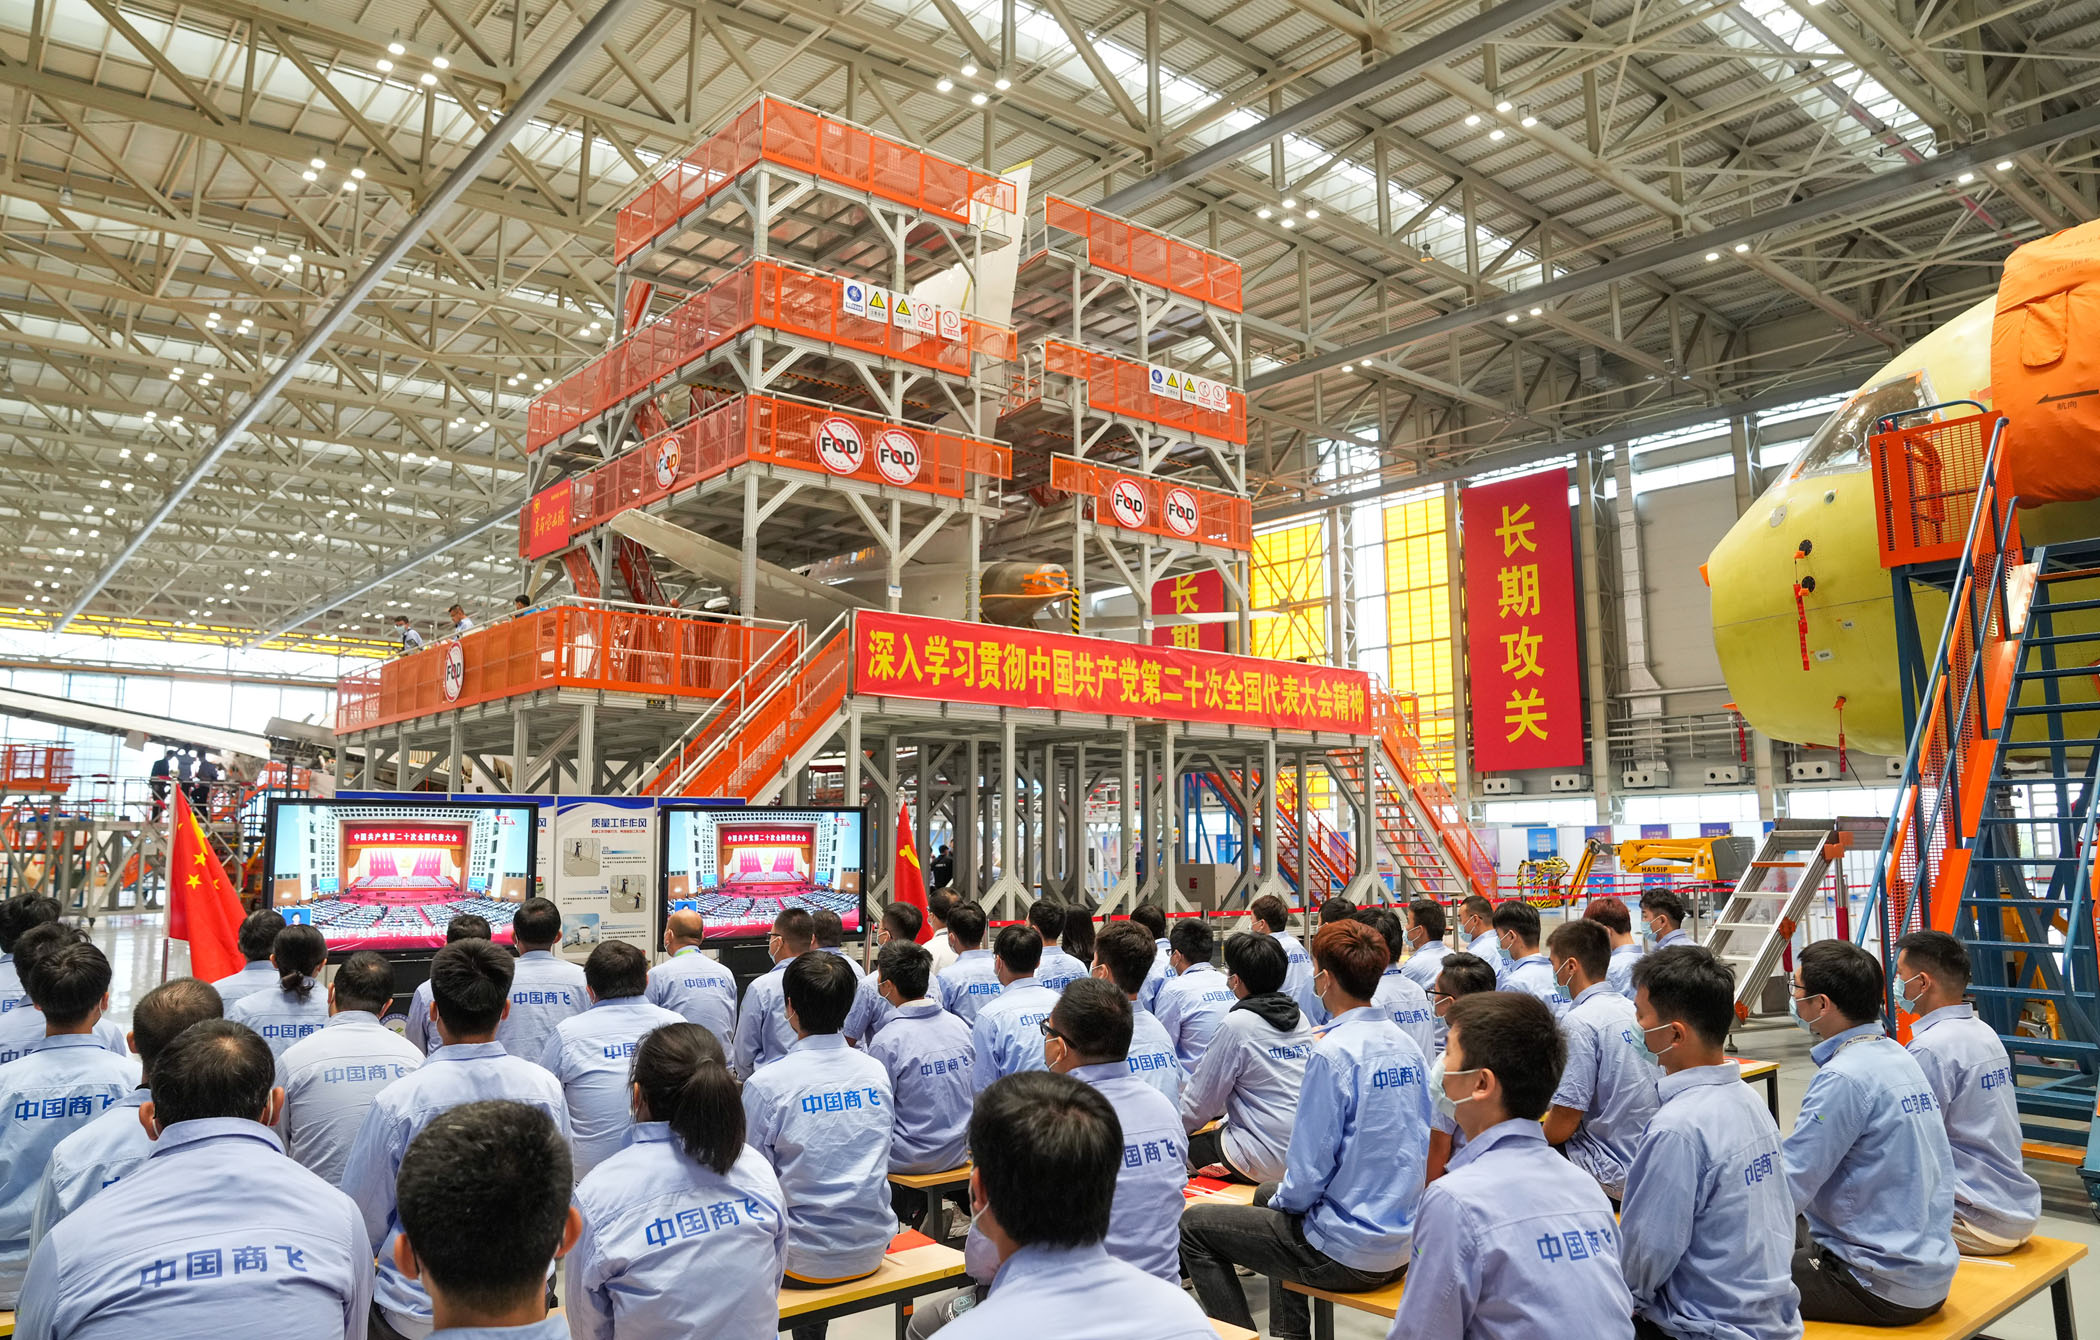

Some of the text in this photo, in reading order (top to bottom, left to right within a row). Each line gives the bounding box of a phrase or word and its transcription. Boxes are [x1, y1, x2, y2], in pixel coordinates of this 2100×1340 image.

[821, 436, 858, 454] FOD
[658, 453, 677, 473] FOD
[880, 448, 915, 466] FOD
[1115, 493, 1142, 513] FOD
[1168, 503, 1194, 521] FOD
[1494, 503, 1548, 743] 长期攻关
[447, 662, 461, 681] FOD
[867, 629, 1364, 723] 深入学习贯彻中国共产党第二十次全国代表大会精神
[591, 818, 647, 828] 质量工作作风
[353, 832, 458, 842] 中国共产党第二十次全国代表大会
[684, 977, 726, 989] 中国商飞
[513, 991, 571, 1005] 中国商飞
[1020, 1013, 1050, 1027] 中国
[1394, 1008, 1430, 1024] 中国商飞
[263, 1024, 324, 1038] 中国商
[920, 1055, 969, 1077] 中国商飞
[1126, 1052, 1175, 1073] 中国商飞
[324, 1063, 405, 1083] 中国商飞
[1373, 1066, 1421, 1090] 中国商飞
[801, 1087, 881, 1114] 中国商飞
[645, 1198, 765, 1247] 中国商飞
[138, 1245, 309, 1289] 中国商飞
